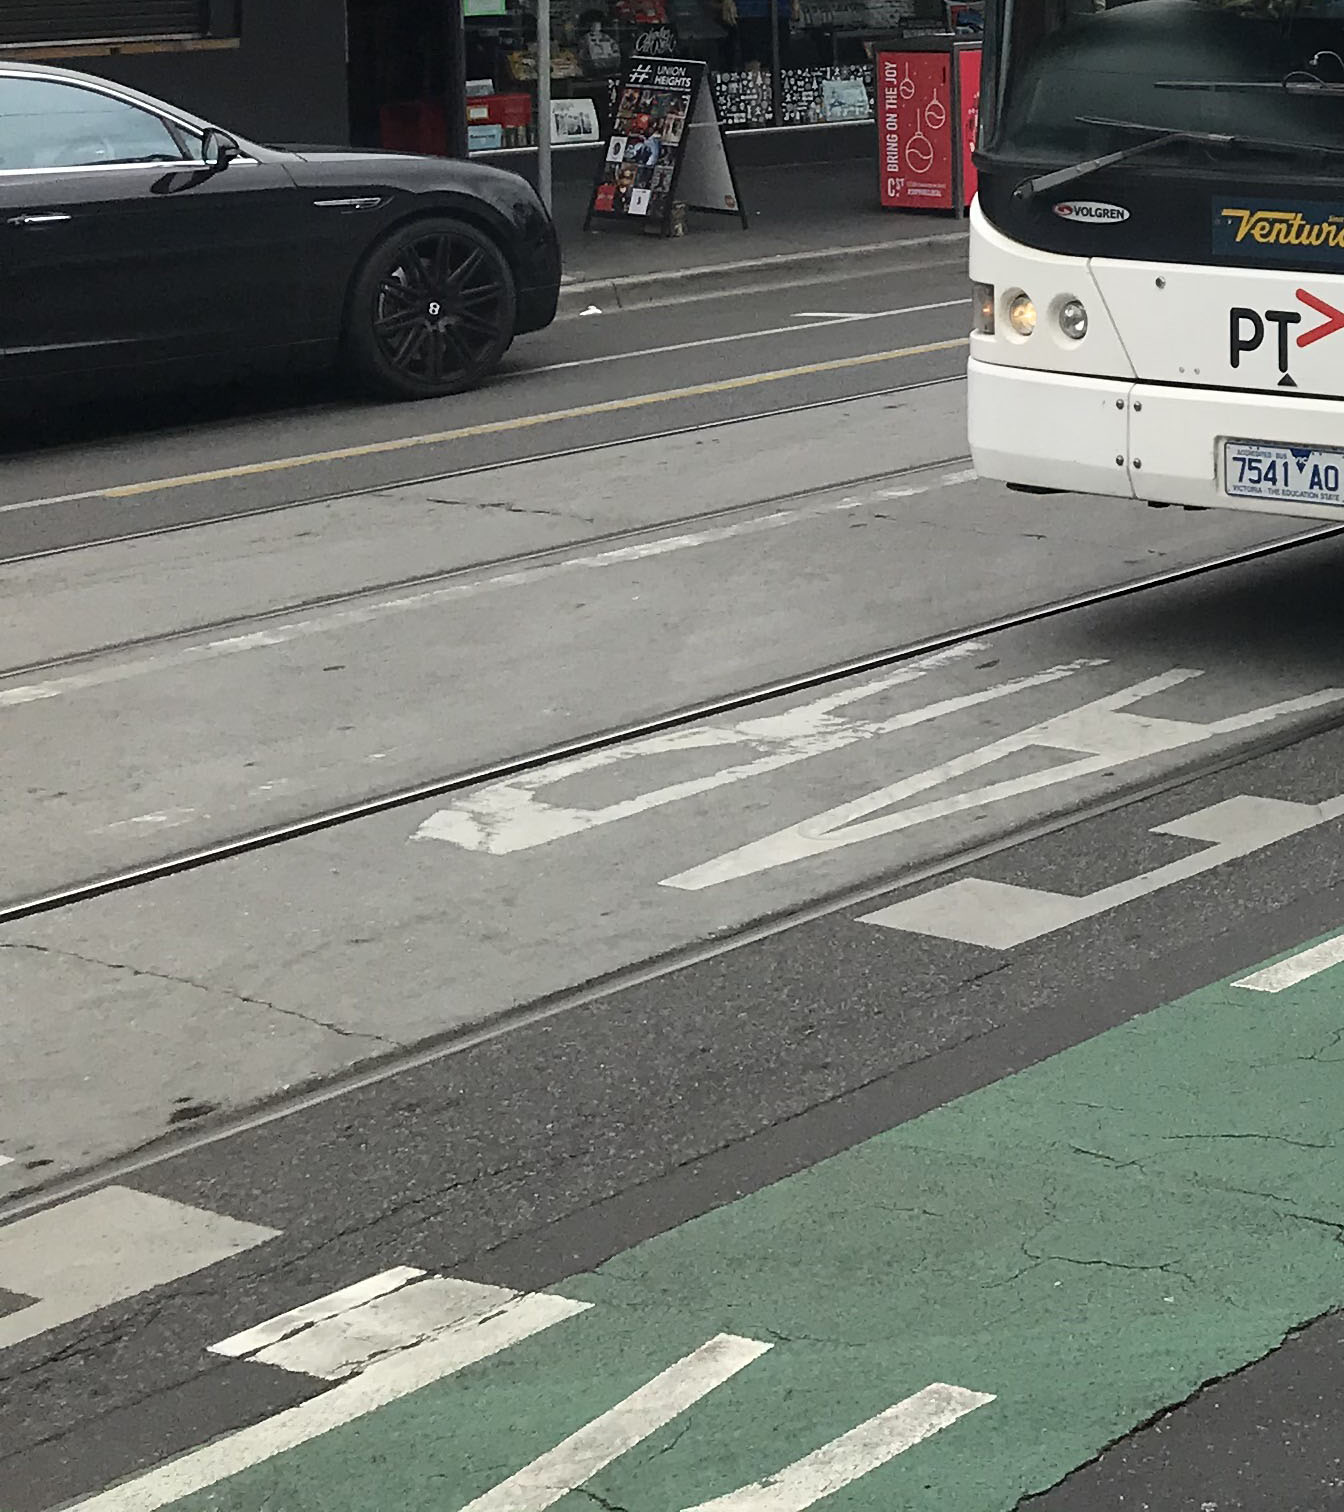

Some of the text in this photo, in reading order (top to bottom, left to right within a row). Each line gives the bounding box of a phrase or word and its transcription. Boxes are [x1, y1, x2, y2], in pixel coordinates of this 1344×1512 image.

[656, 65, 687, 76] UNION
[654, 74, 692, 88] HEIGHTS
[884, 61, 899, 172] BRING ON THE JOY
[1074, 205, 1125, 220] VOLGREN
[1230, 306, 1302, 373] PT
[1232, 456, 1289, 487] 7541
[1232, 484, 1263, 494] VICTORIA
[1281, 488, 1319, 499] EDUCATION
[1320, 492, 1340, 502] STATE
